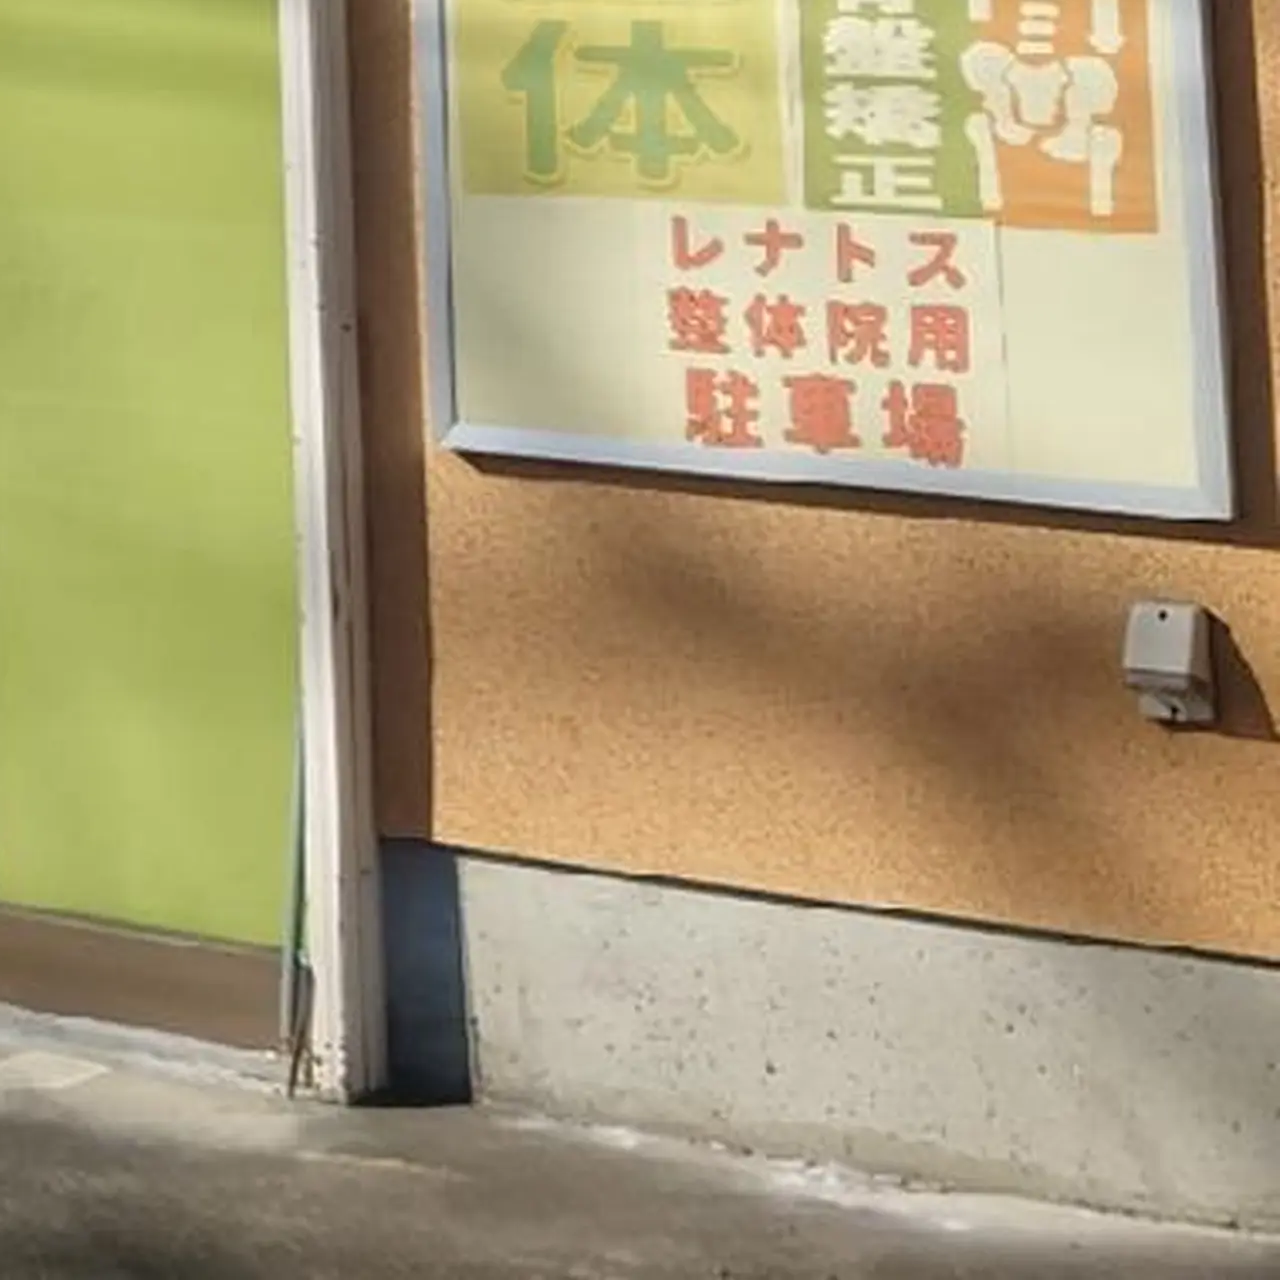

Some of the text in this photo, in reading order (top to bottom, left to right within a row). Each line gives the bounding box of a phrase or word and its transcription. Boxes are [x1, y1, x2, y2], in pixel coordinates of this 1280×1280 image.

[670, 214, 966, 290] レナトス
[667, 286, 971, 374] 整体院用
[685, 366, 967, 468] 駐車場
